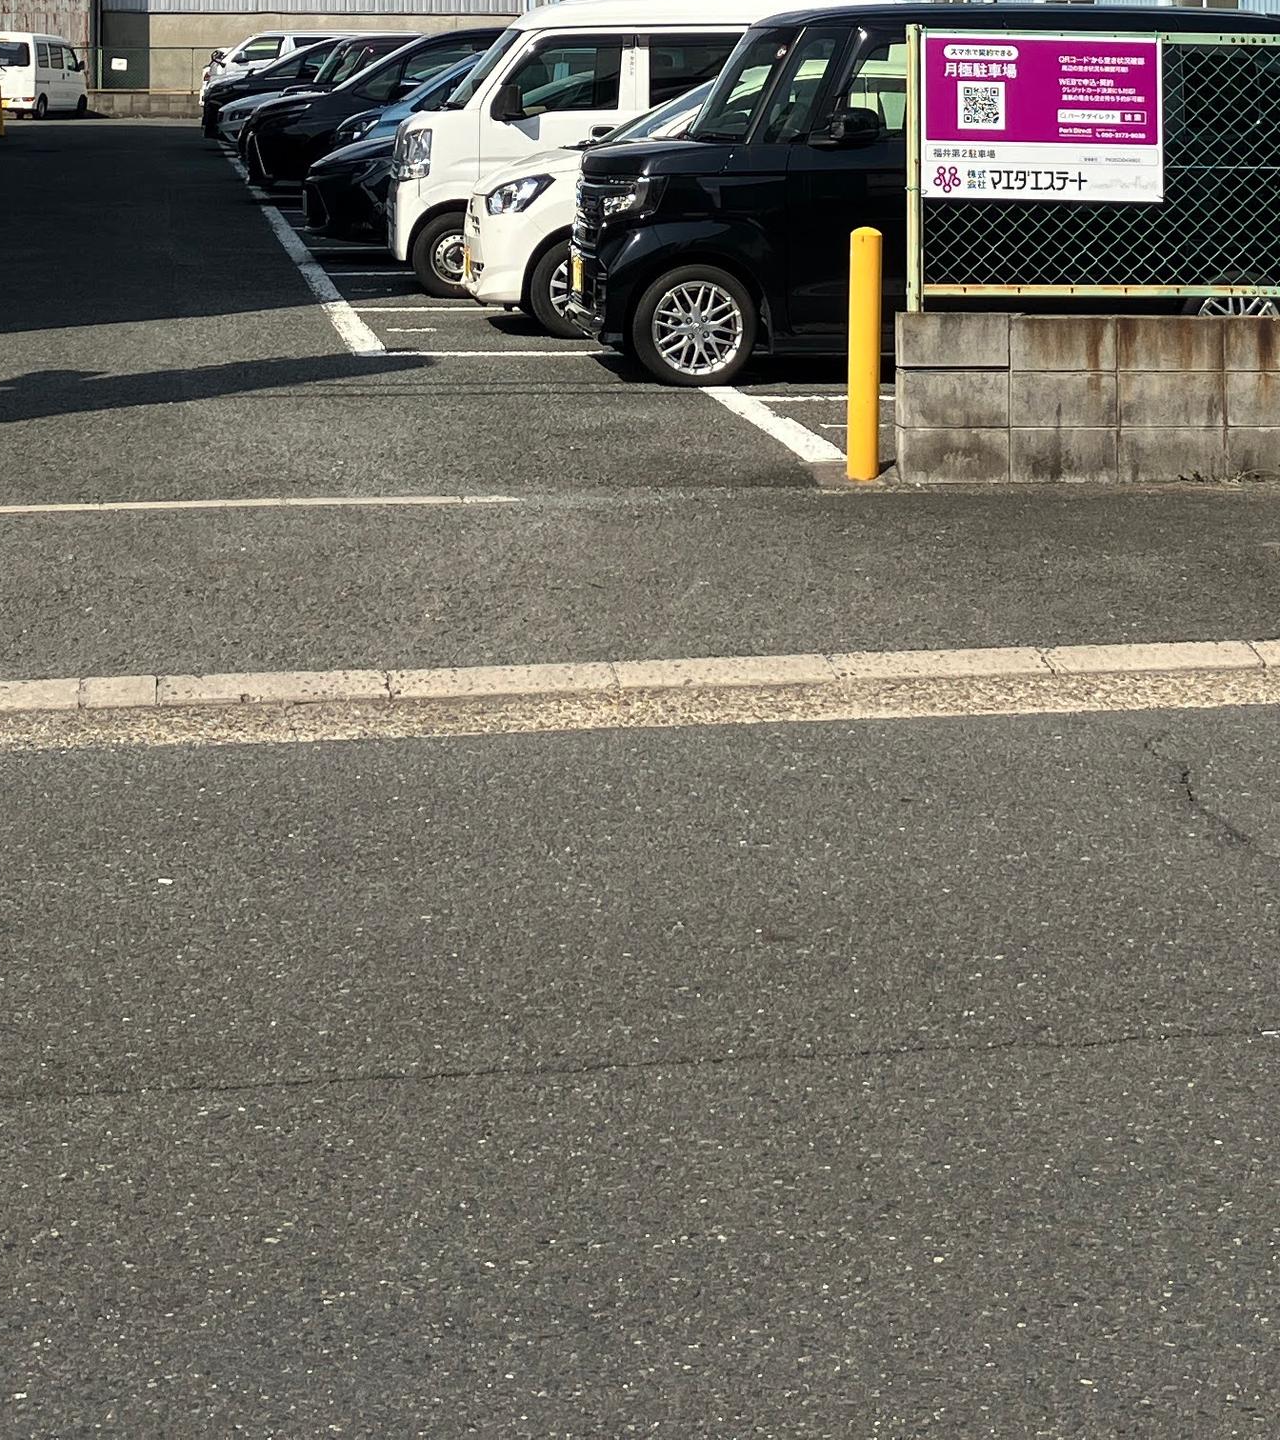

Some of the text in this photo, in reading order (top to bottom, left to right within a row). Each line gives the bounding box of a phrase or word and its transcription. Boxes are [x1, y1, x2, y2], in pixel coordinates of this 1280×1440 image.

[950, 48, 1013, 57] スマホで契約できる
[944, 62, 1017, 79] 月極駐車場
[989, 170, 1088, 191] マエダエステート
